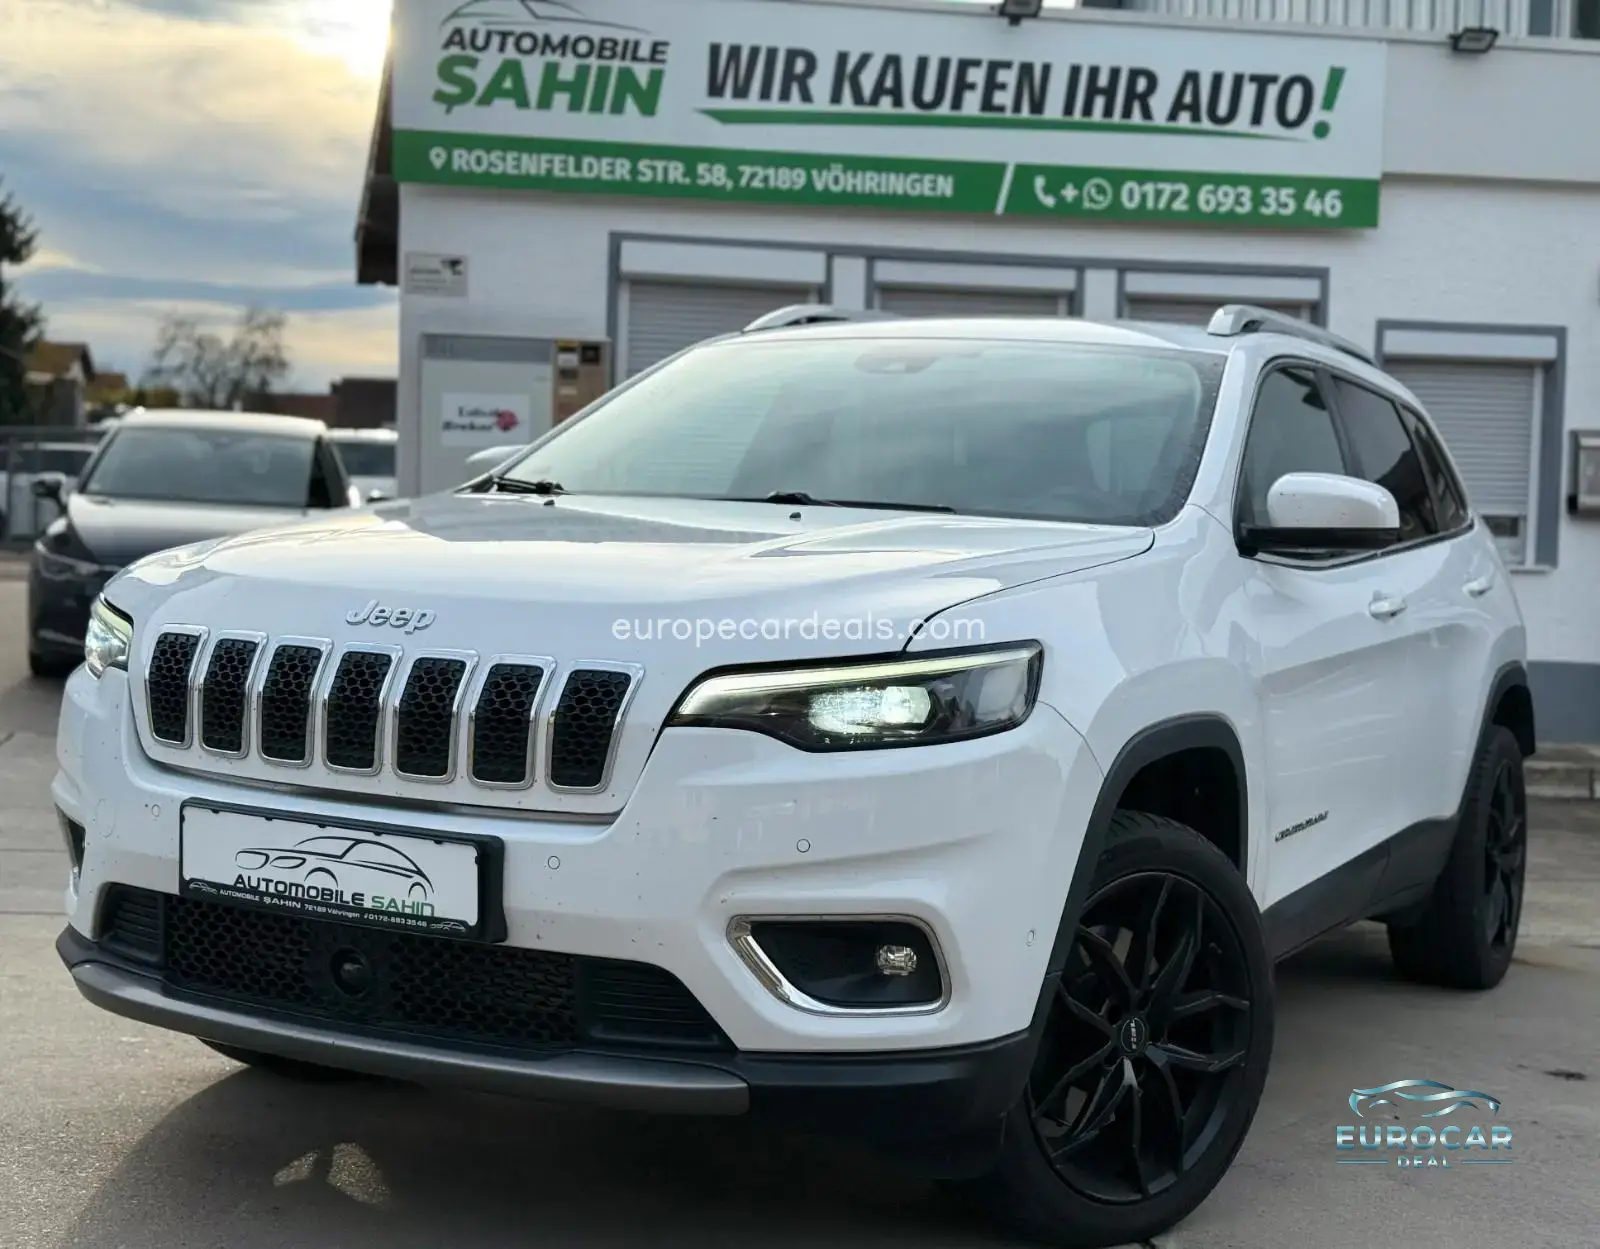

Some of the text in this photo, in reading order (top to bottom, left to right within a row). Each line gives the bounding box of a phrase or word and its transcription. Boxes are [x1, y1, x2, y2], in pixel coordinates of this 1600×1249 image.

[443, 27, 670, 64] AUTOMOBILE
[707, 42, 1346, 140] WIR KAUFEN IHR AUTO!
[452, 148, 954, 199] ROSENFELDER STR. 58, 72189 VÖHRINGEN
[1120, 180, 1190, 212] 0172
[1197, 185, 1254, 215] 693
[1259, 188, 1296, 217] 35
[1304, 189, 1343, 219] 46
[346, 599, 436, 635] Jeep
[219, 889, 261, 901] AUTOMOBILE
[233, 873, 435, 918] AUTOMOBILE SAHIN
